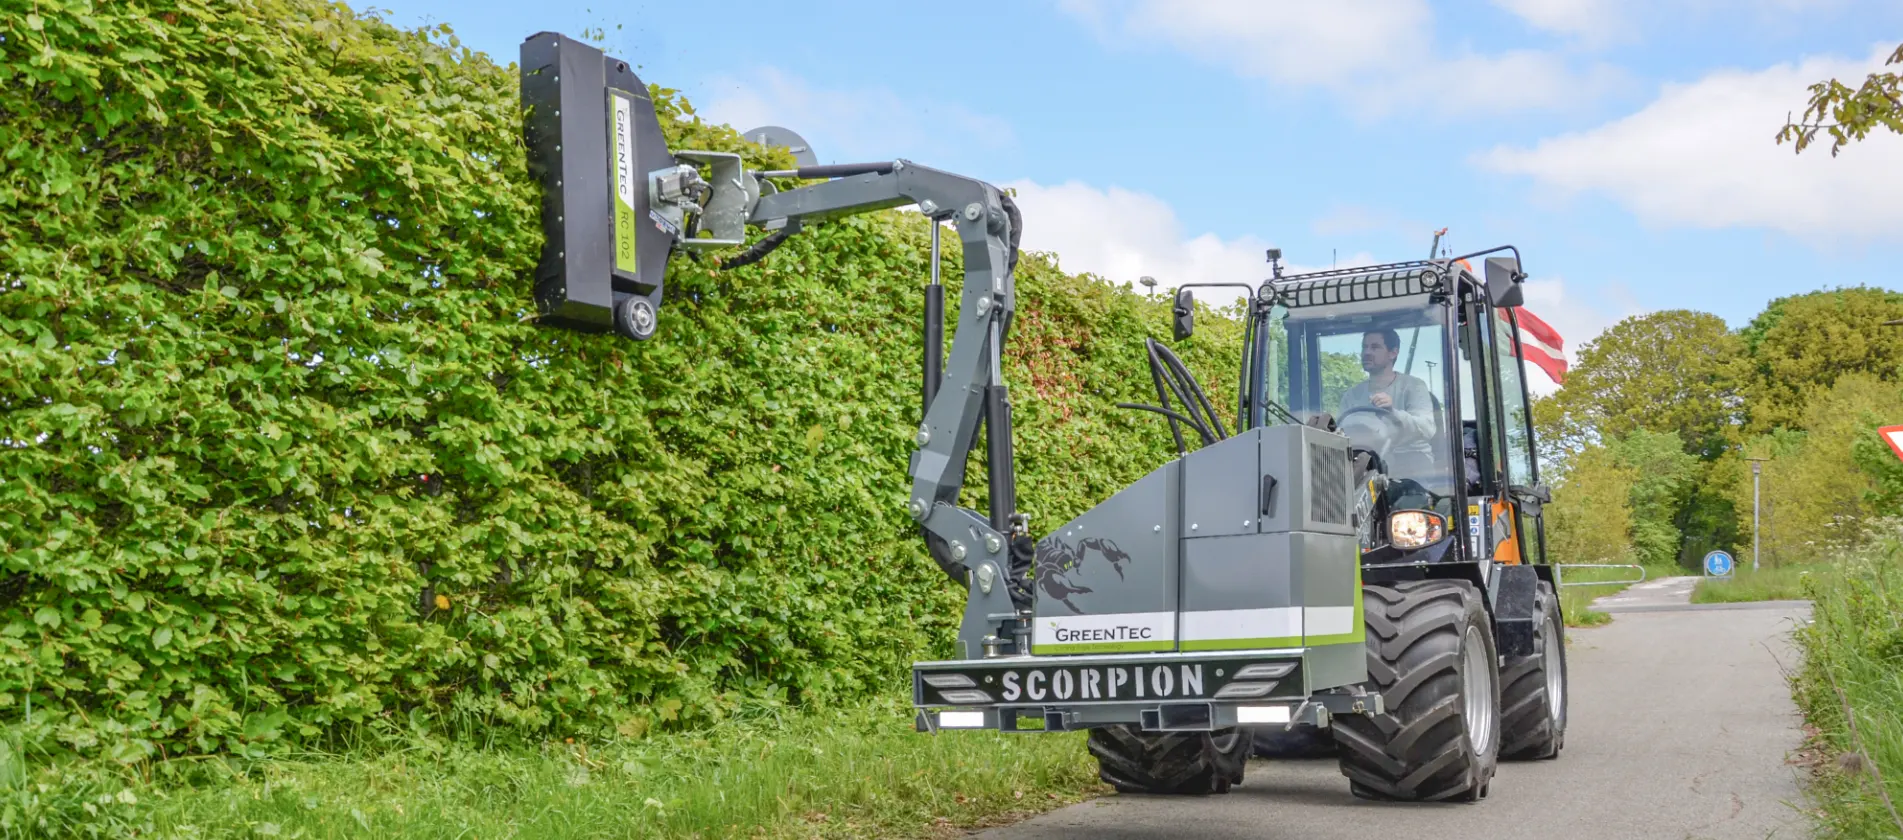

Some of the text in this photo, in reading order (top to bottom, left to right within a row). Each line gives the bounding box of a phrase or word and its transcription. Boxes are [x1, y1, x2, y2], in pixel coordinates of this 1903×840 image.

[620, 211, 629, 230] RC
[621, 234, 630, 259] 102
[1055, 625, 1152, 642] GREENTEC
[1002, 664, 1204, 701] SCORPION
